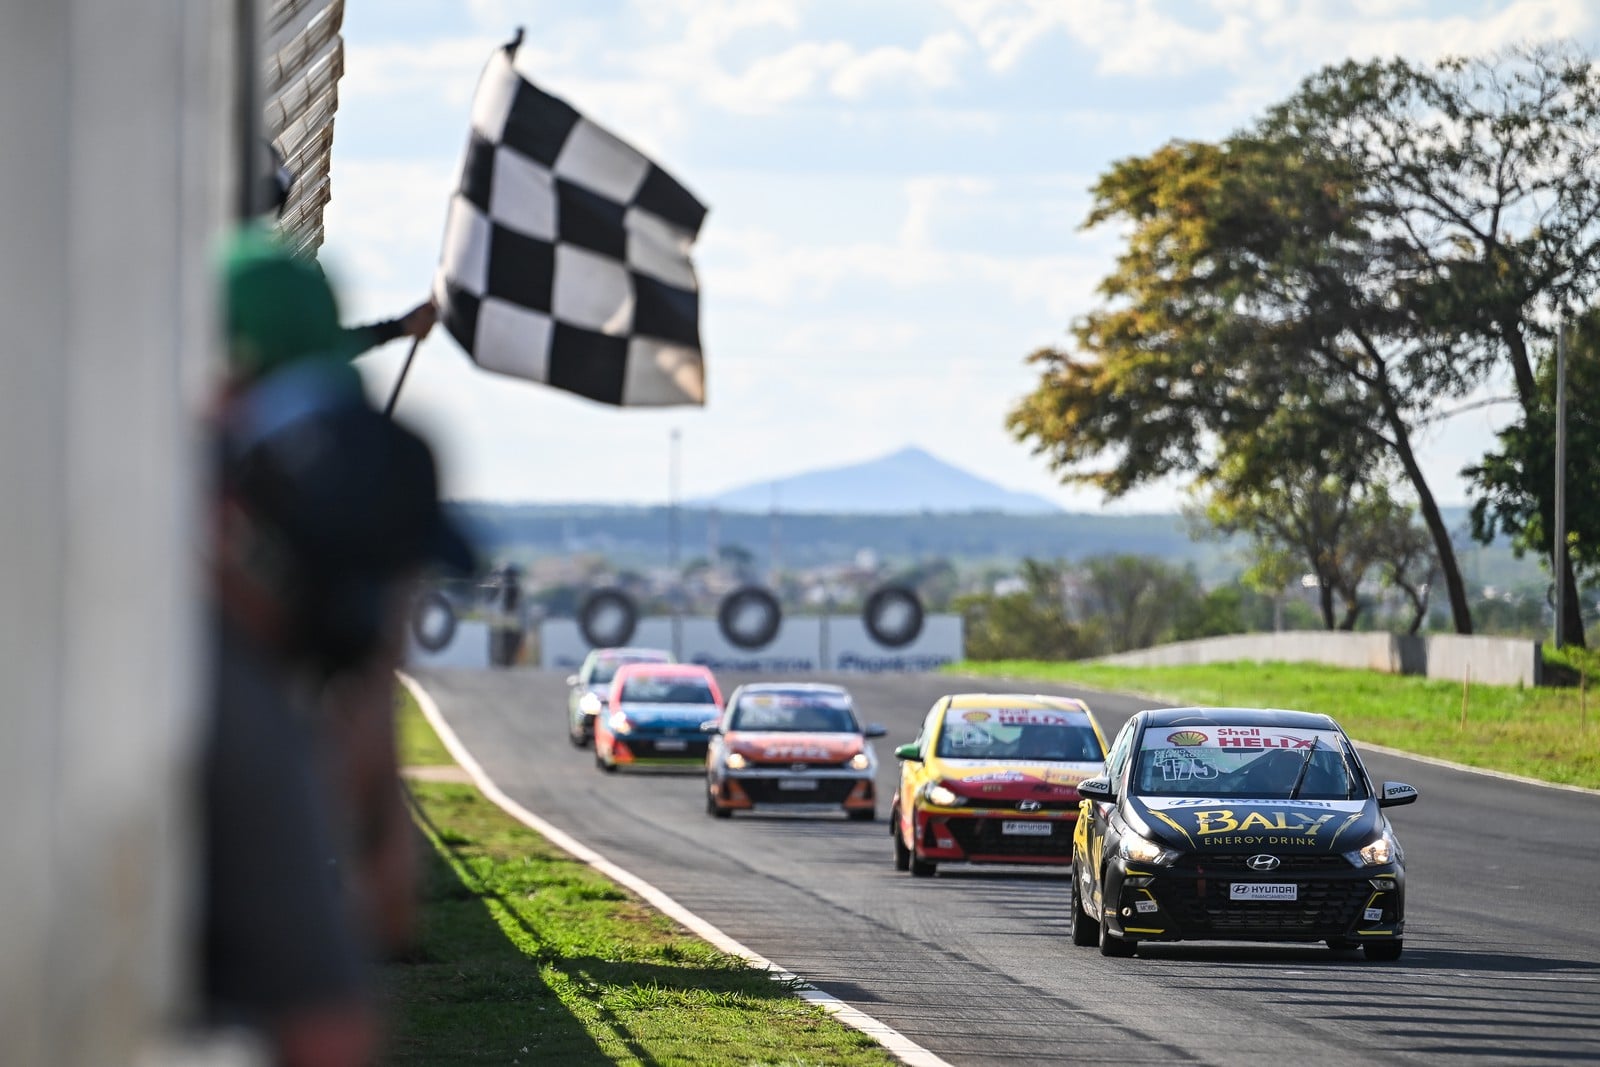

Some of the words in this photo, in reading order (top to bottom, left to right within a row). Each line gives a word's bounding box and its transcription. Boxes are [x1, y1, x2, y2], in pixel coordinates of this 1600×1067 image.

[1217, 728, 1260, 736] Shell
[1217, 737, 1317, 749] HELIX
[1155, 758, 1219, 780] 175
[1193, 810, 1336, 836] BALY
[1204, 836, 1264, 845] ENERGY
[1269, 837, 1316, 846] DRINK
[1251, 886, 1295, 894] HYUNDAI
